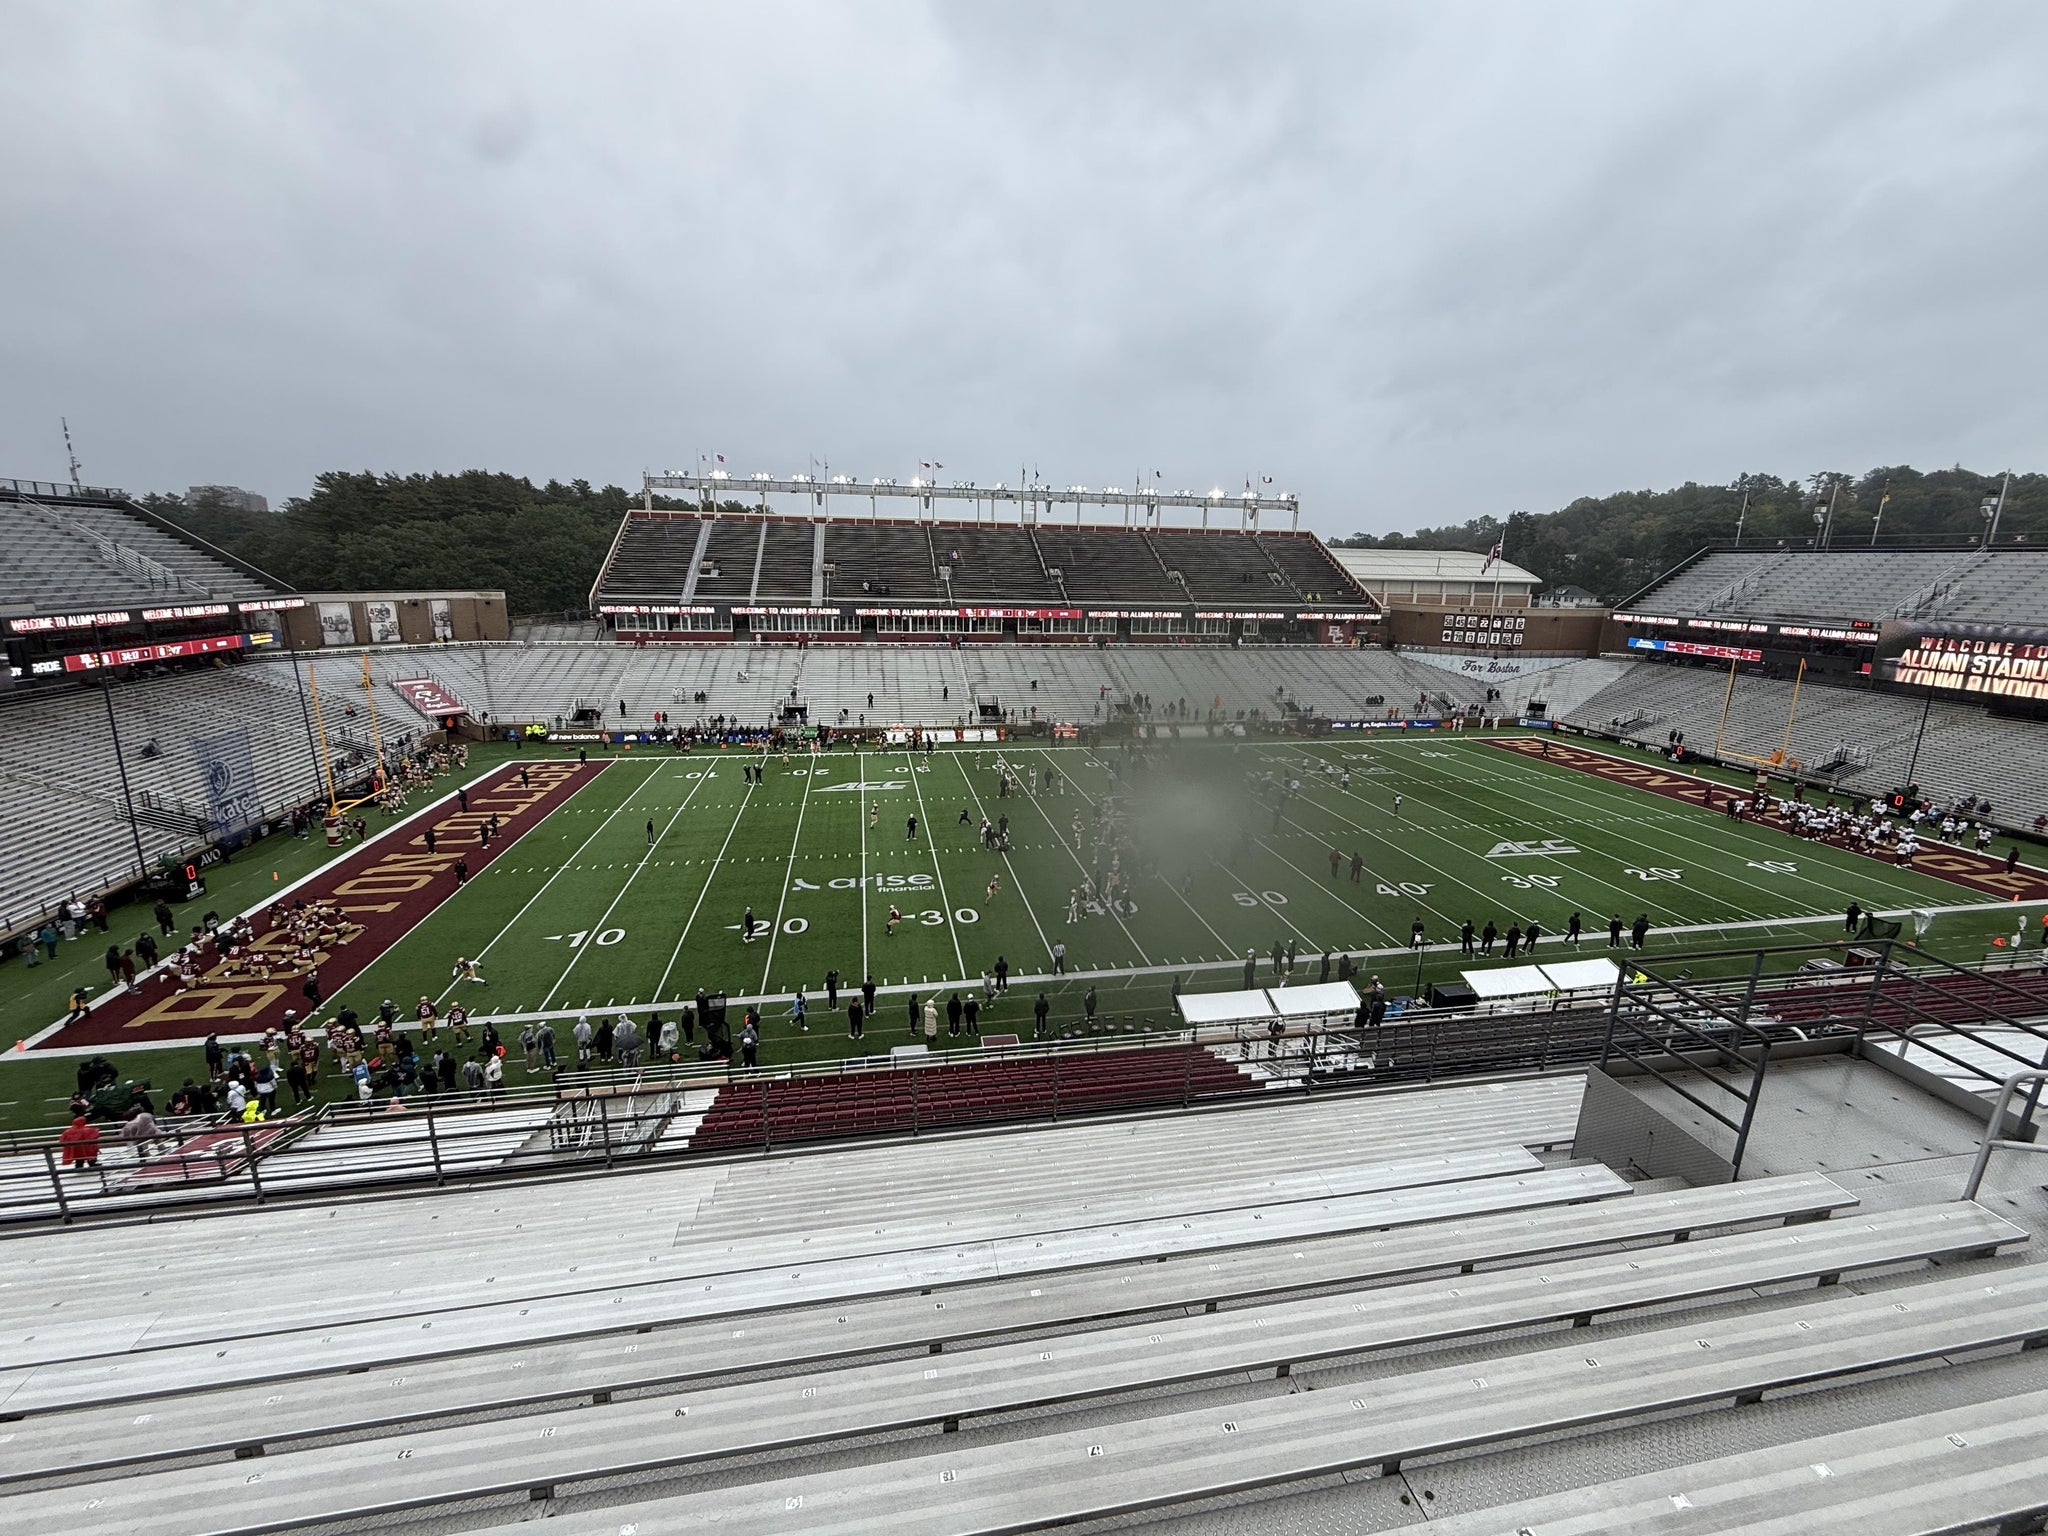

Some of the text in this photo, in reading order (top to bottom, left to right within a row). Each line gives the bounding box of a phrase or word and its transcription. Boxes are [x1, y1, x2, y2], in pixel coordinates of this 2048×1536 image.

[323, 616, 333, 625] 40
[1919, 636, 2048, 659] WELCOME TO
[1461, 659, 1521, 673] For Boston
[1898, 649, 2048, 681] ALUMNI STADIU
[1676, 745, 1683, 755] 0
[1493, 739, 1697, 787] BOSTON
[685, 771, 719, 780] 10
[792, 768, 830, 777] 20
[373, 780, 379, 791] 0
[1894, 795, 1904, 806] 0
[1486, 838, 1579, 857] ACC
[200, 848, 221, 867] AVO
[186, 865, 196, 880] 0
[1624, 867, 1683, 881] 20
[1746, 860, 1799, 874] 10
[828, 872, 933, 889] arise
[1500, 874, 1559, 889] 30
[877, 883, 935, 893] financial
[1376, 881, 1428, 897] 40
[121, 762, 585, 1029] BOSTON COLLEGE
[1230, 890, 1290, 907] 50
[919, 907, 980, 926] 30
[743, 917, 810, 937] 20
[567, 928, 627, 947] 10
[253, 954, 263, 962] 52
[420, 1007, 430, 1016] 51
[1042, 1352, 1051, 1360] 17
[804, 1388, 815, 1397] 19
[1224, 1422, 1236, 1432] 16
[397, 1451, 413, 1459] 22
